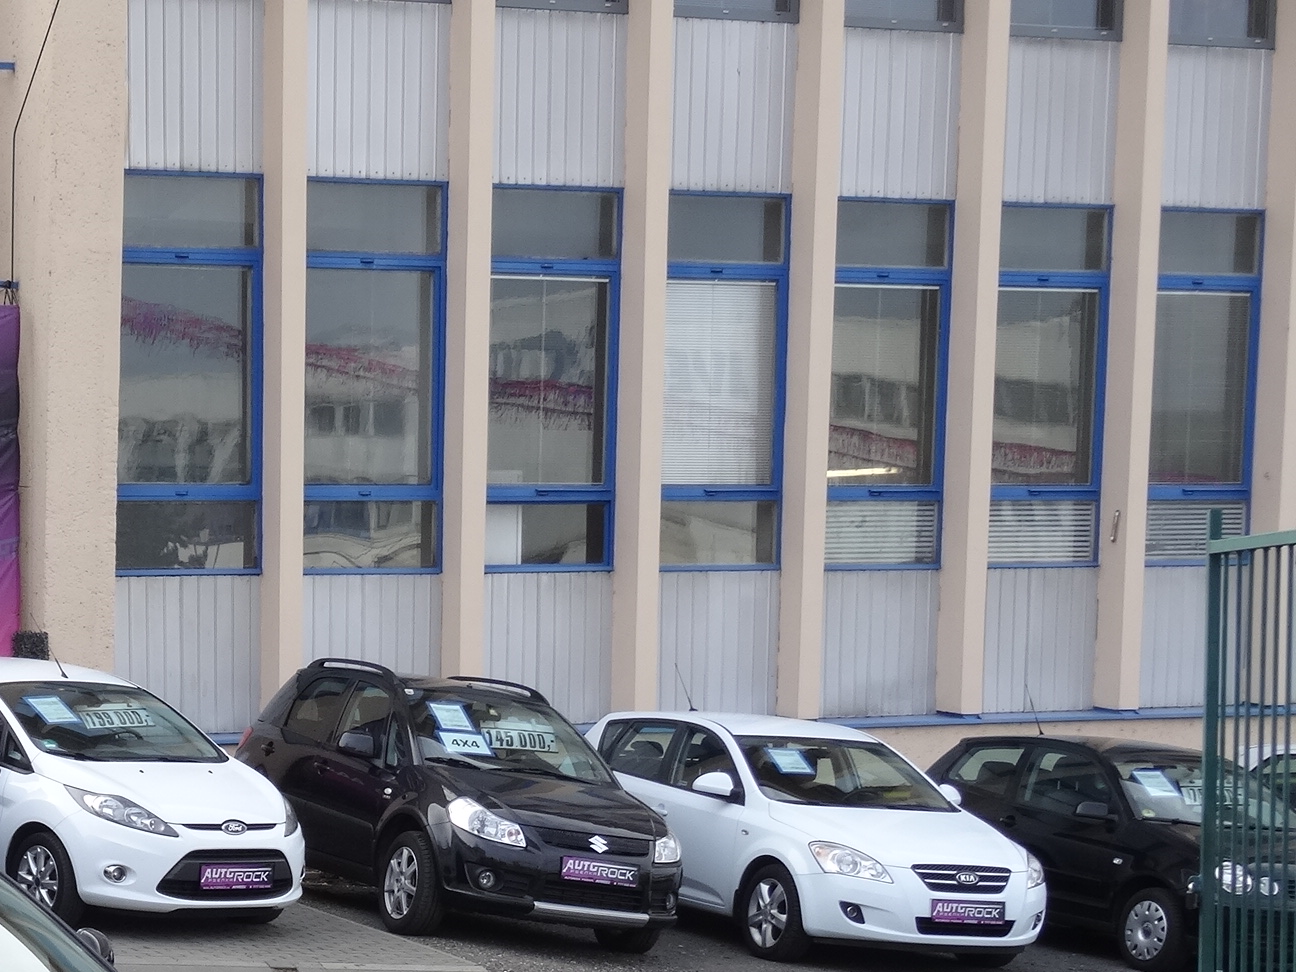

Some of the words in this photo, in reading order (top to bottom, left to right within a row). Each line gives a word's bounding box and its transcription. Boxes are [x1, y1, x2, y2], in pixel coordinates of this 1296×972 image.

[200, 867, 272, 883] AUTOROCK
[562, 859, 637, 881] AUTOROCK
[959, 874, 976, 882] KIA
[932, 902, 1003, 918] AUTOROCK
